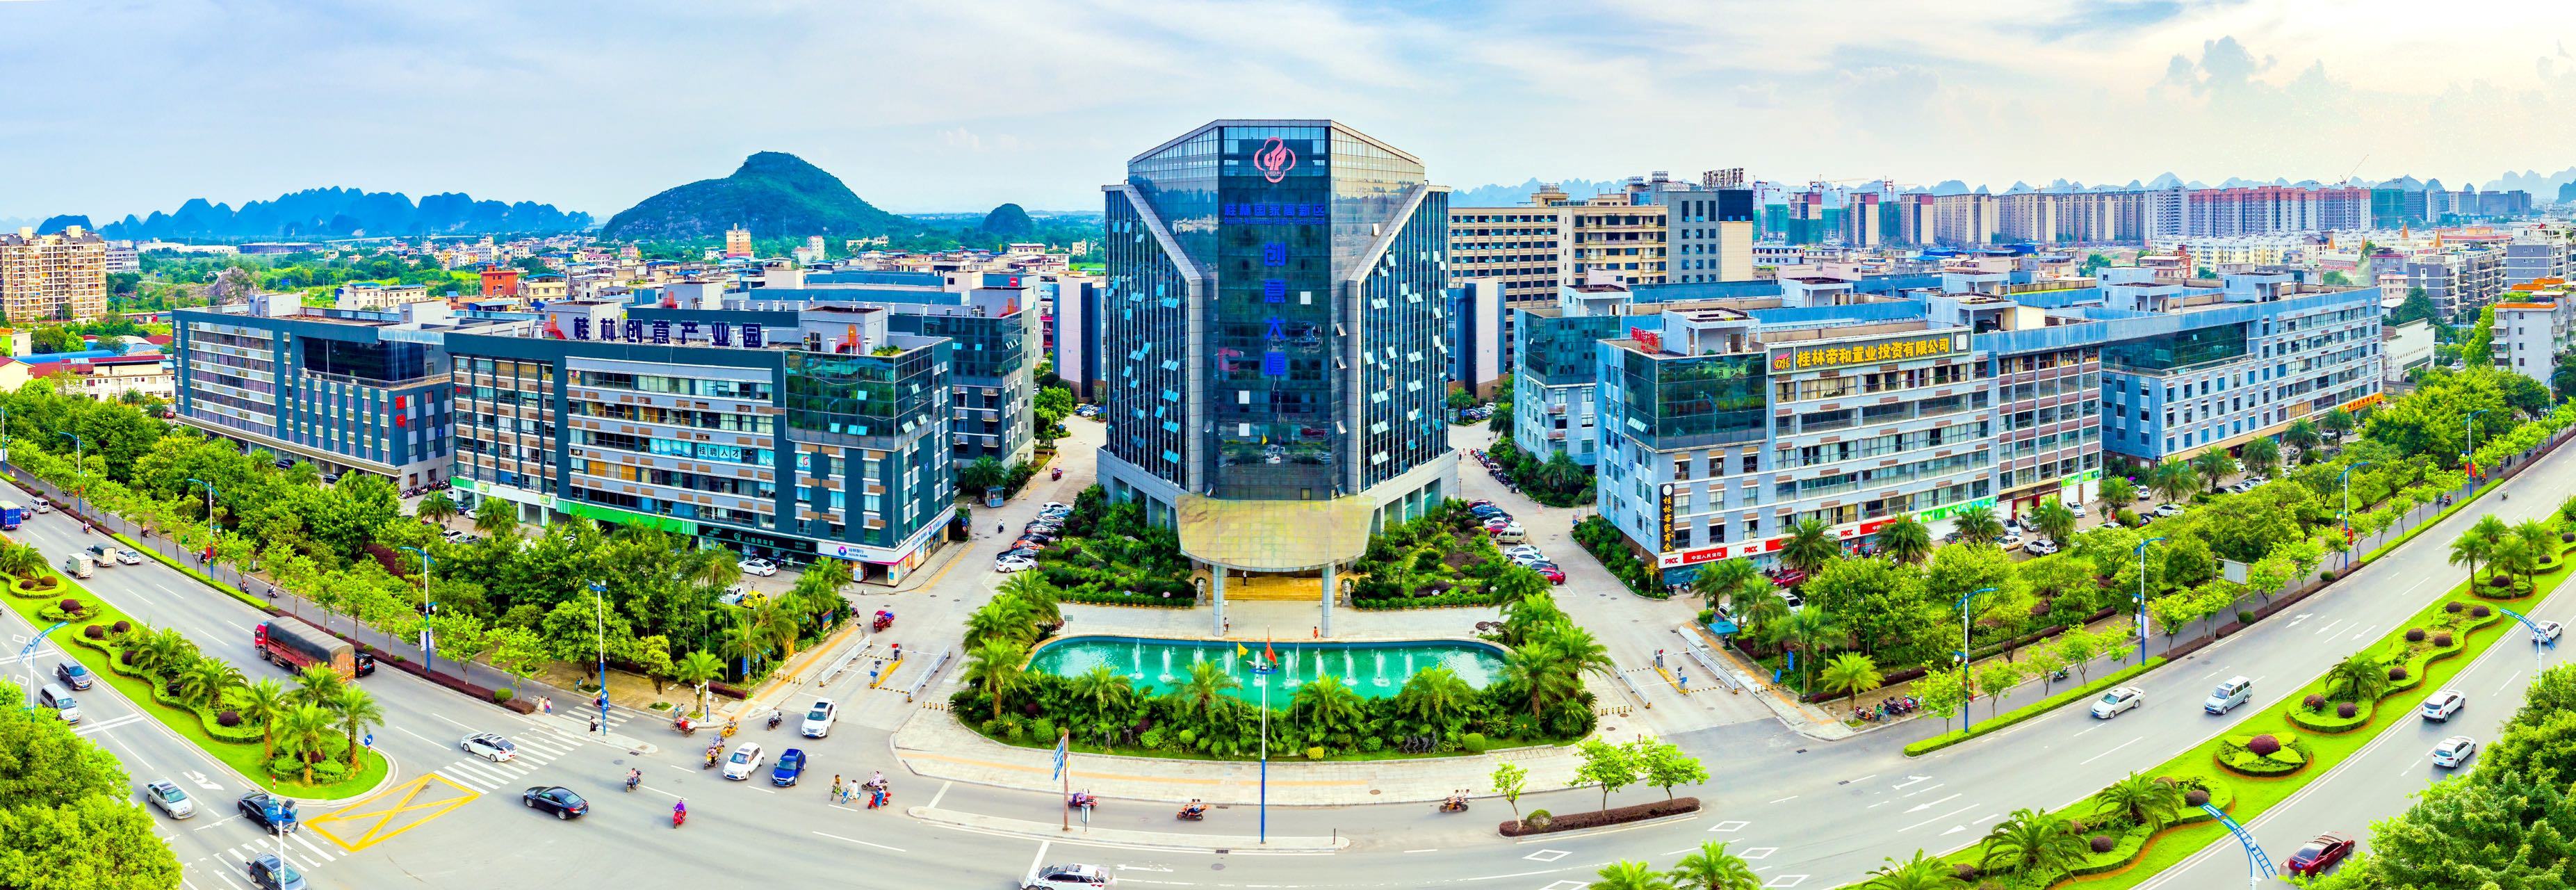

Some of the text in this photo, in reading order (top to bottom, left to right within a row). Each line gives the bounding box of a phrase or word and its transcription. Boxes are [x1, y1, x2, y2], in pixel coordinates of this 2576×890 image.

[1224, 203, 1325, 216] 桂林国家高新区
[1264, 241, 1286, 375] 创意大厦
[573, 316, 763, 348] 桂林创意产业园
[1797, 338, 1949, 368] 桂林帝和置业投资有限公司
[699, 444, 740, 458] 桂聘人才
[1840, 528, 1853, 537] PICC
[1691, 551, 1722, 560] 中国人民保险
[1744, 546, 1757, 554] PICC
